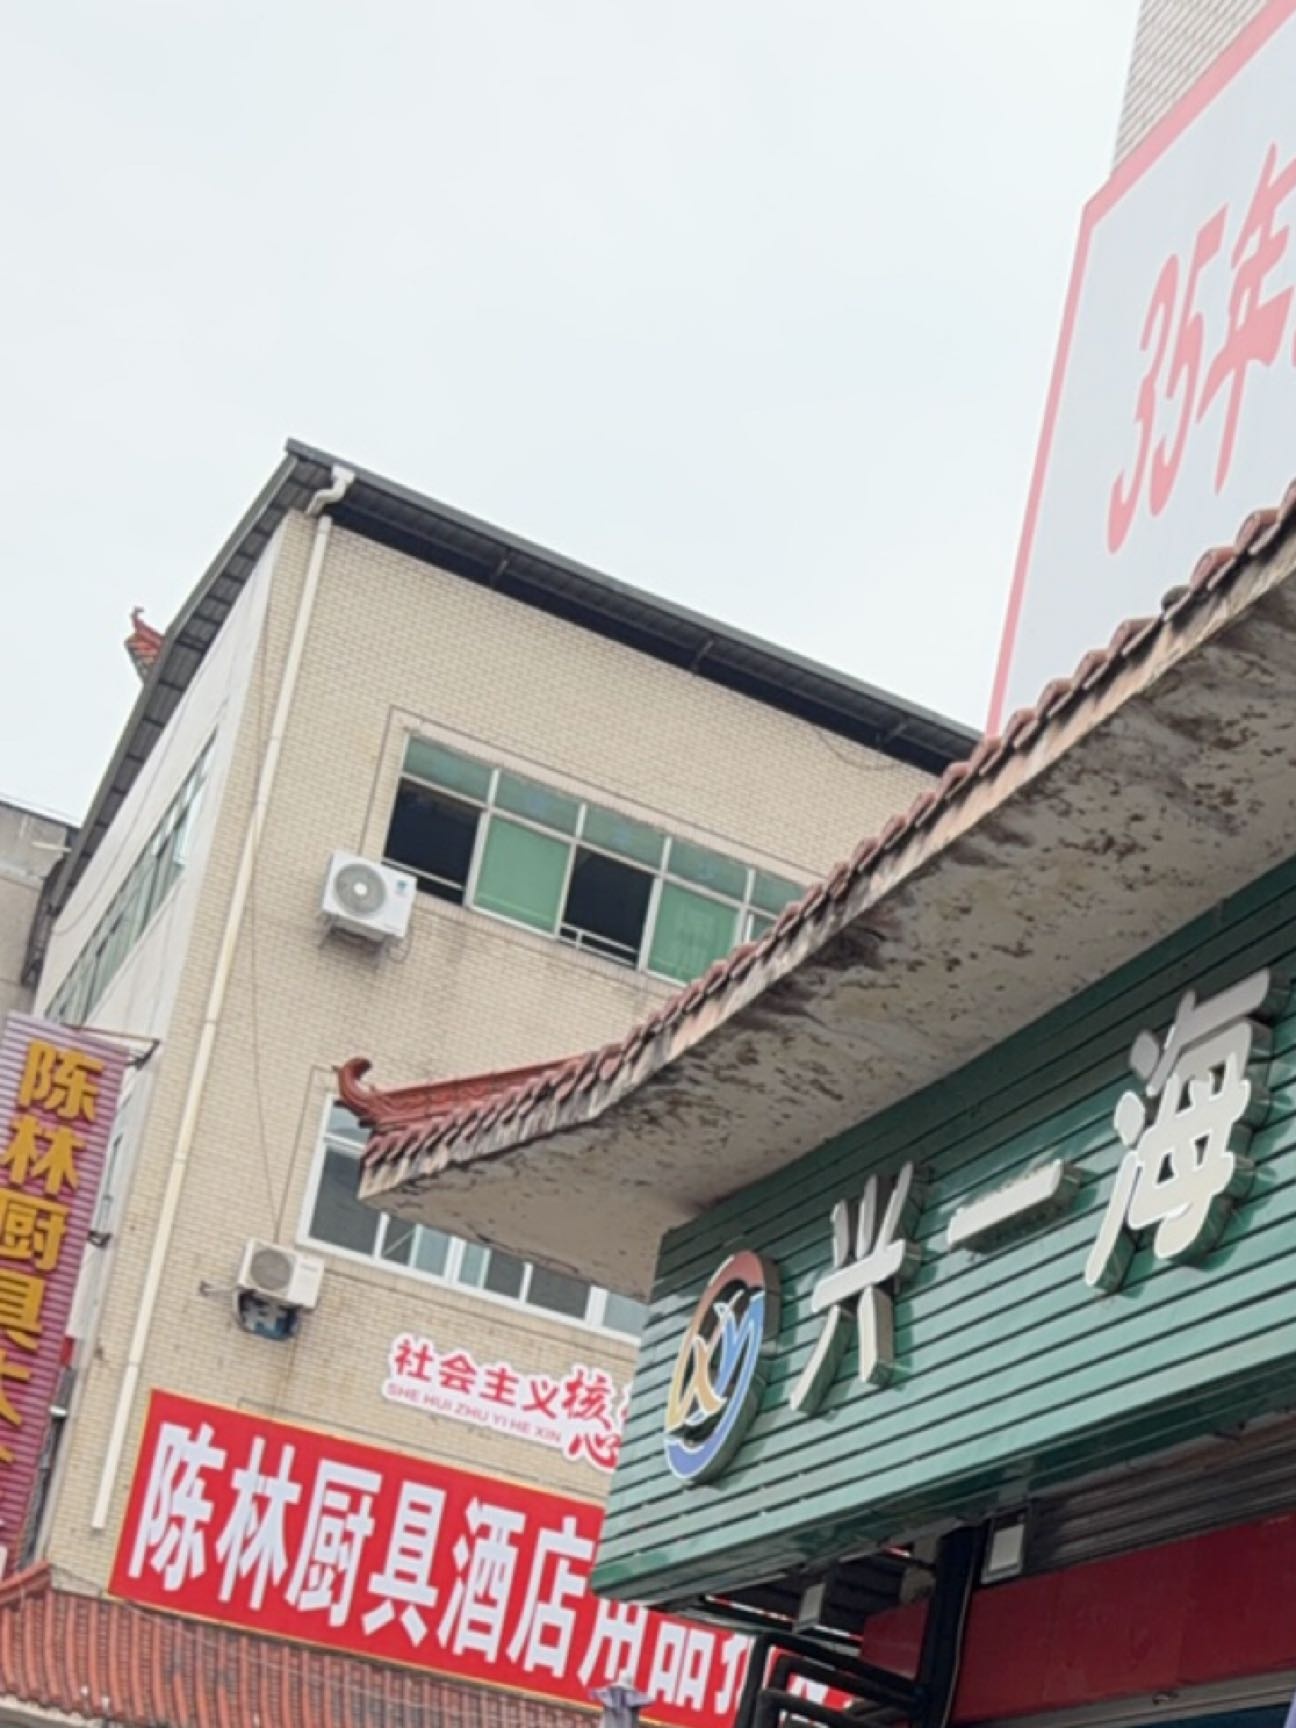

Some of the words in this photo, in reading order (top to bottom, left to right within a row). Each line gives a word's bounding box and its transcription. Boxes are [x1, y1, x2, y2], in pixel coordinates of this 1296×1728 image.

[0, 1040, 103, 1464] 陈林厨具
[387, 1382, 418, 1403] SHE
[423, 1392, 449, 1412] HUI
[453, 1402, 489, 1422] ZHU
[509, 1417, 531, 1433] HE
[535, 1426, 562, 1443] XIN
